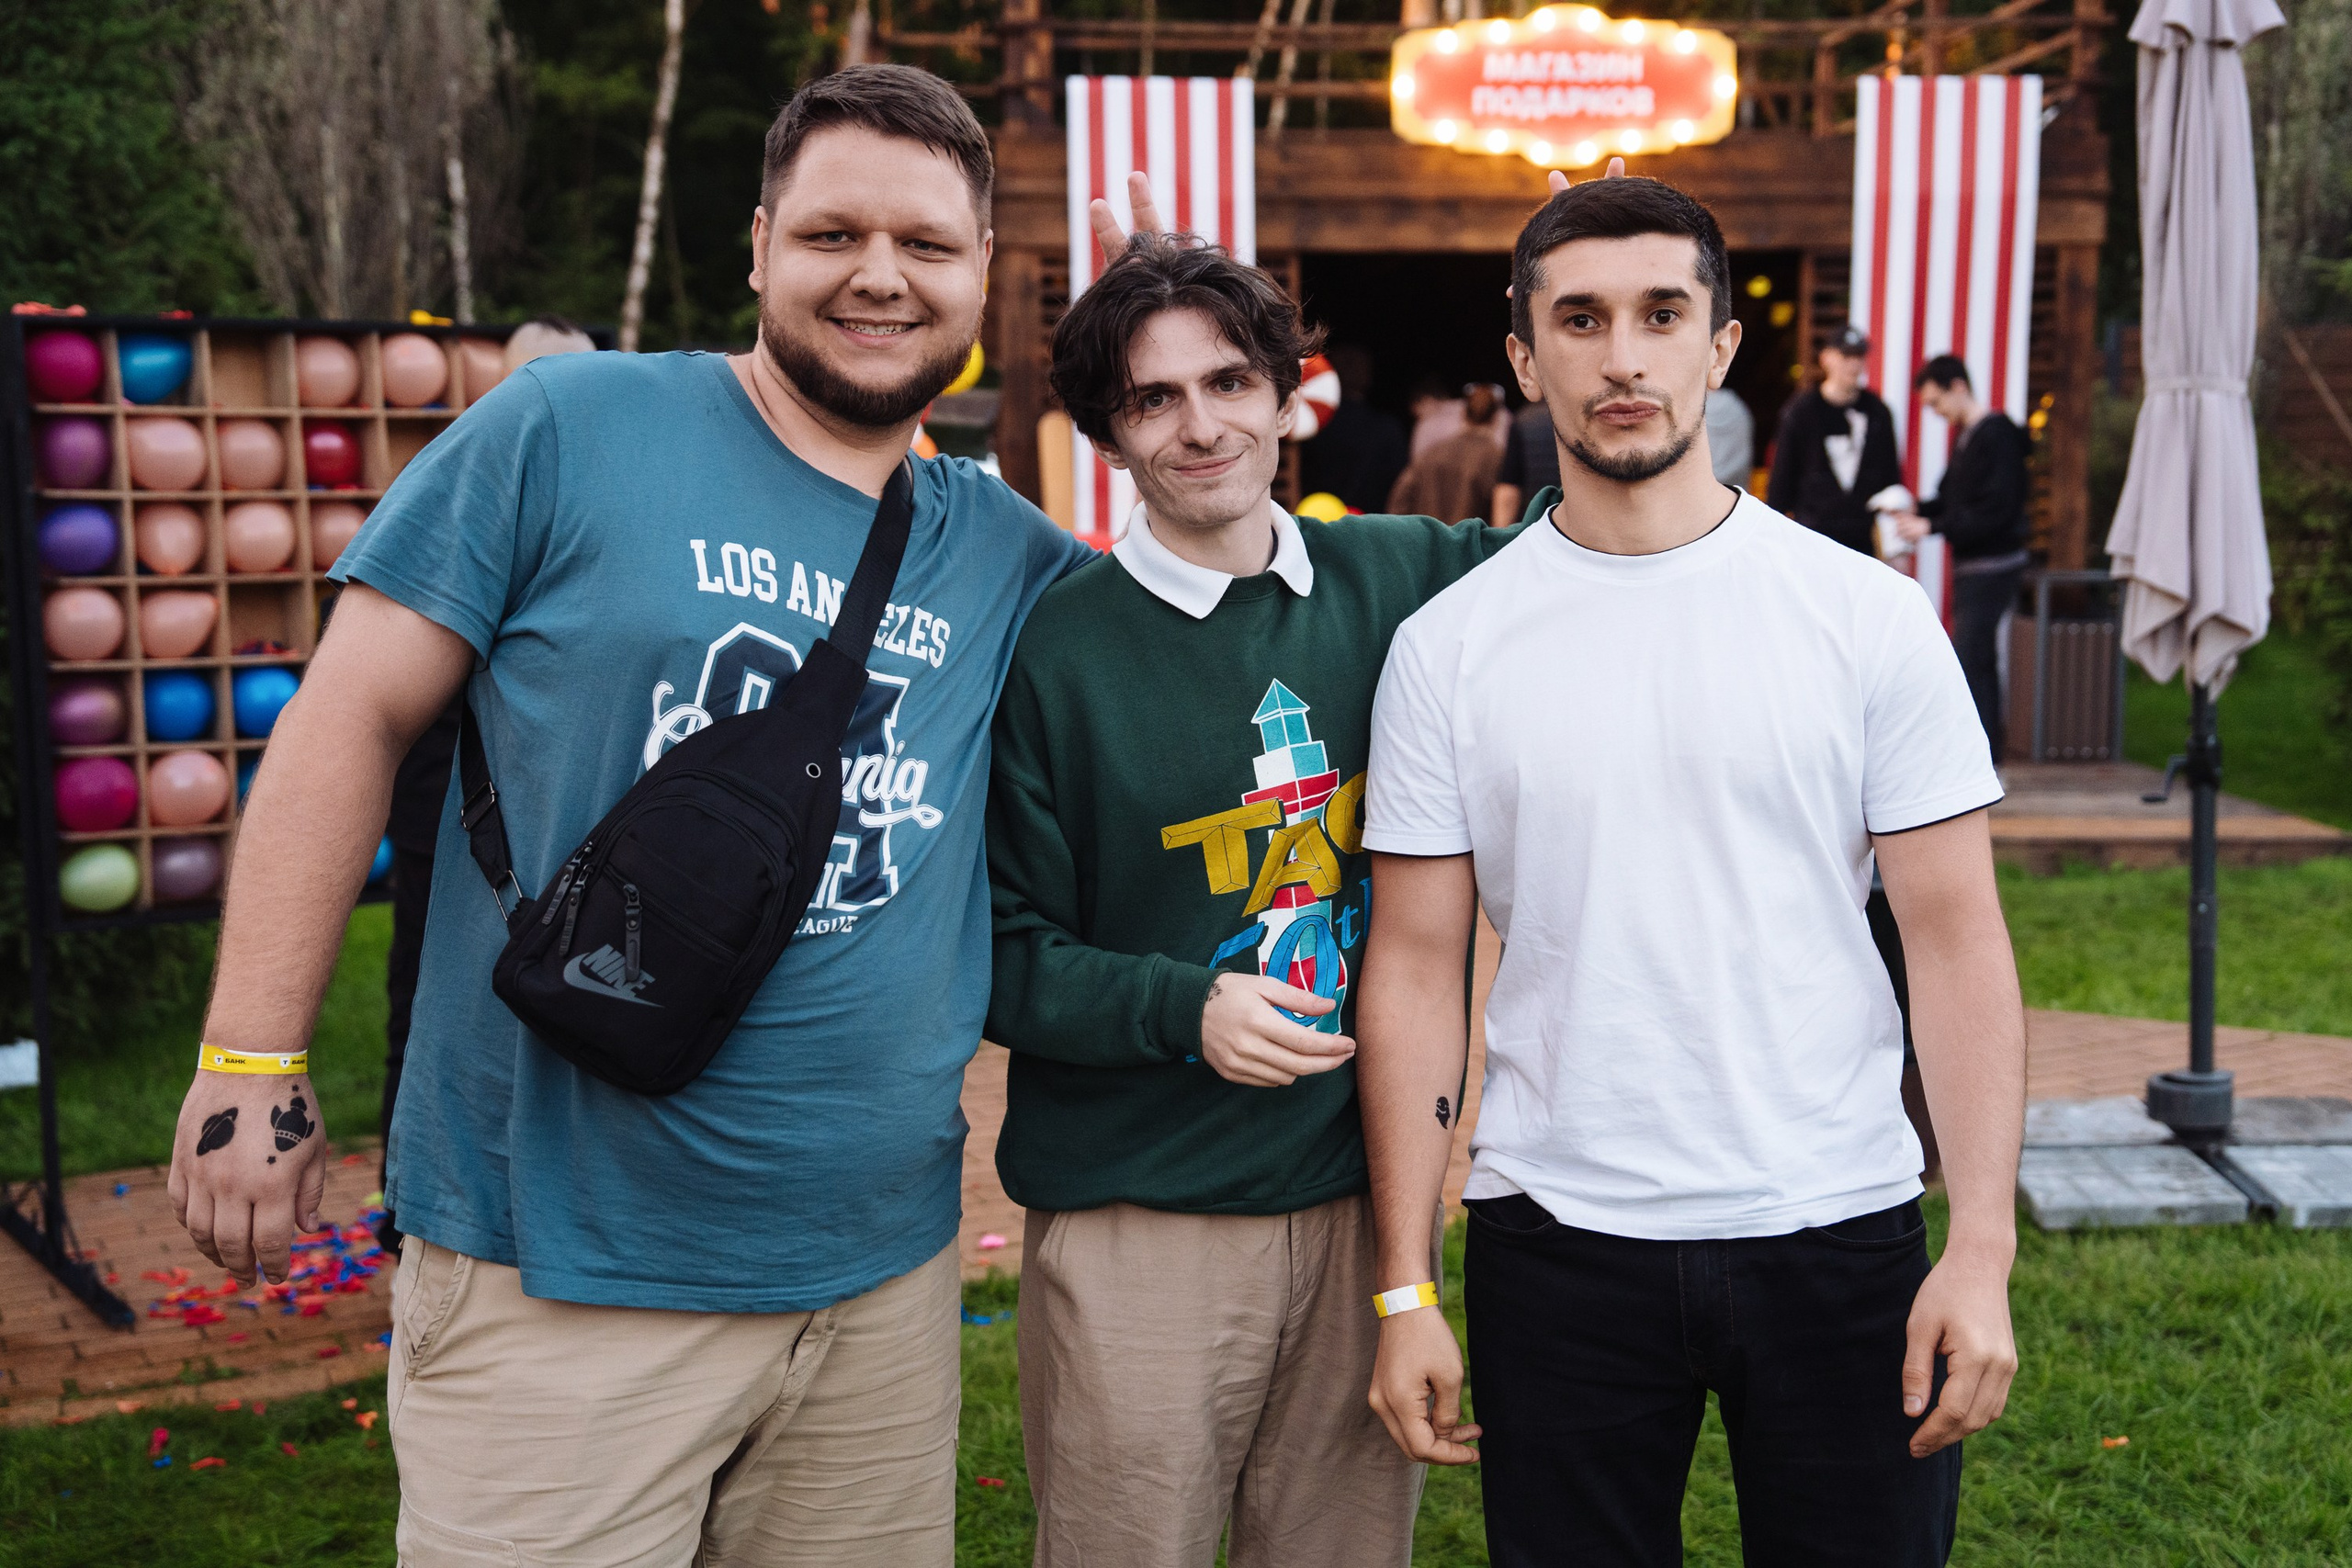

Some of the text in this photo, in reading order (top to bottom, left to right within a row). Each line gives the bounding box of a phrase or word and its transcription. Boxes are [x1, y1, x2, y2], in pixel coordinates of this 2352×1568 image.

[1482, 51, 1645, 83] МАГАЗИН
[1471, 85, 1655, 120] ПОДАРКОВ
[690, 539, 950, 669] LOS ANELES
